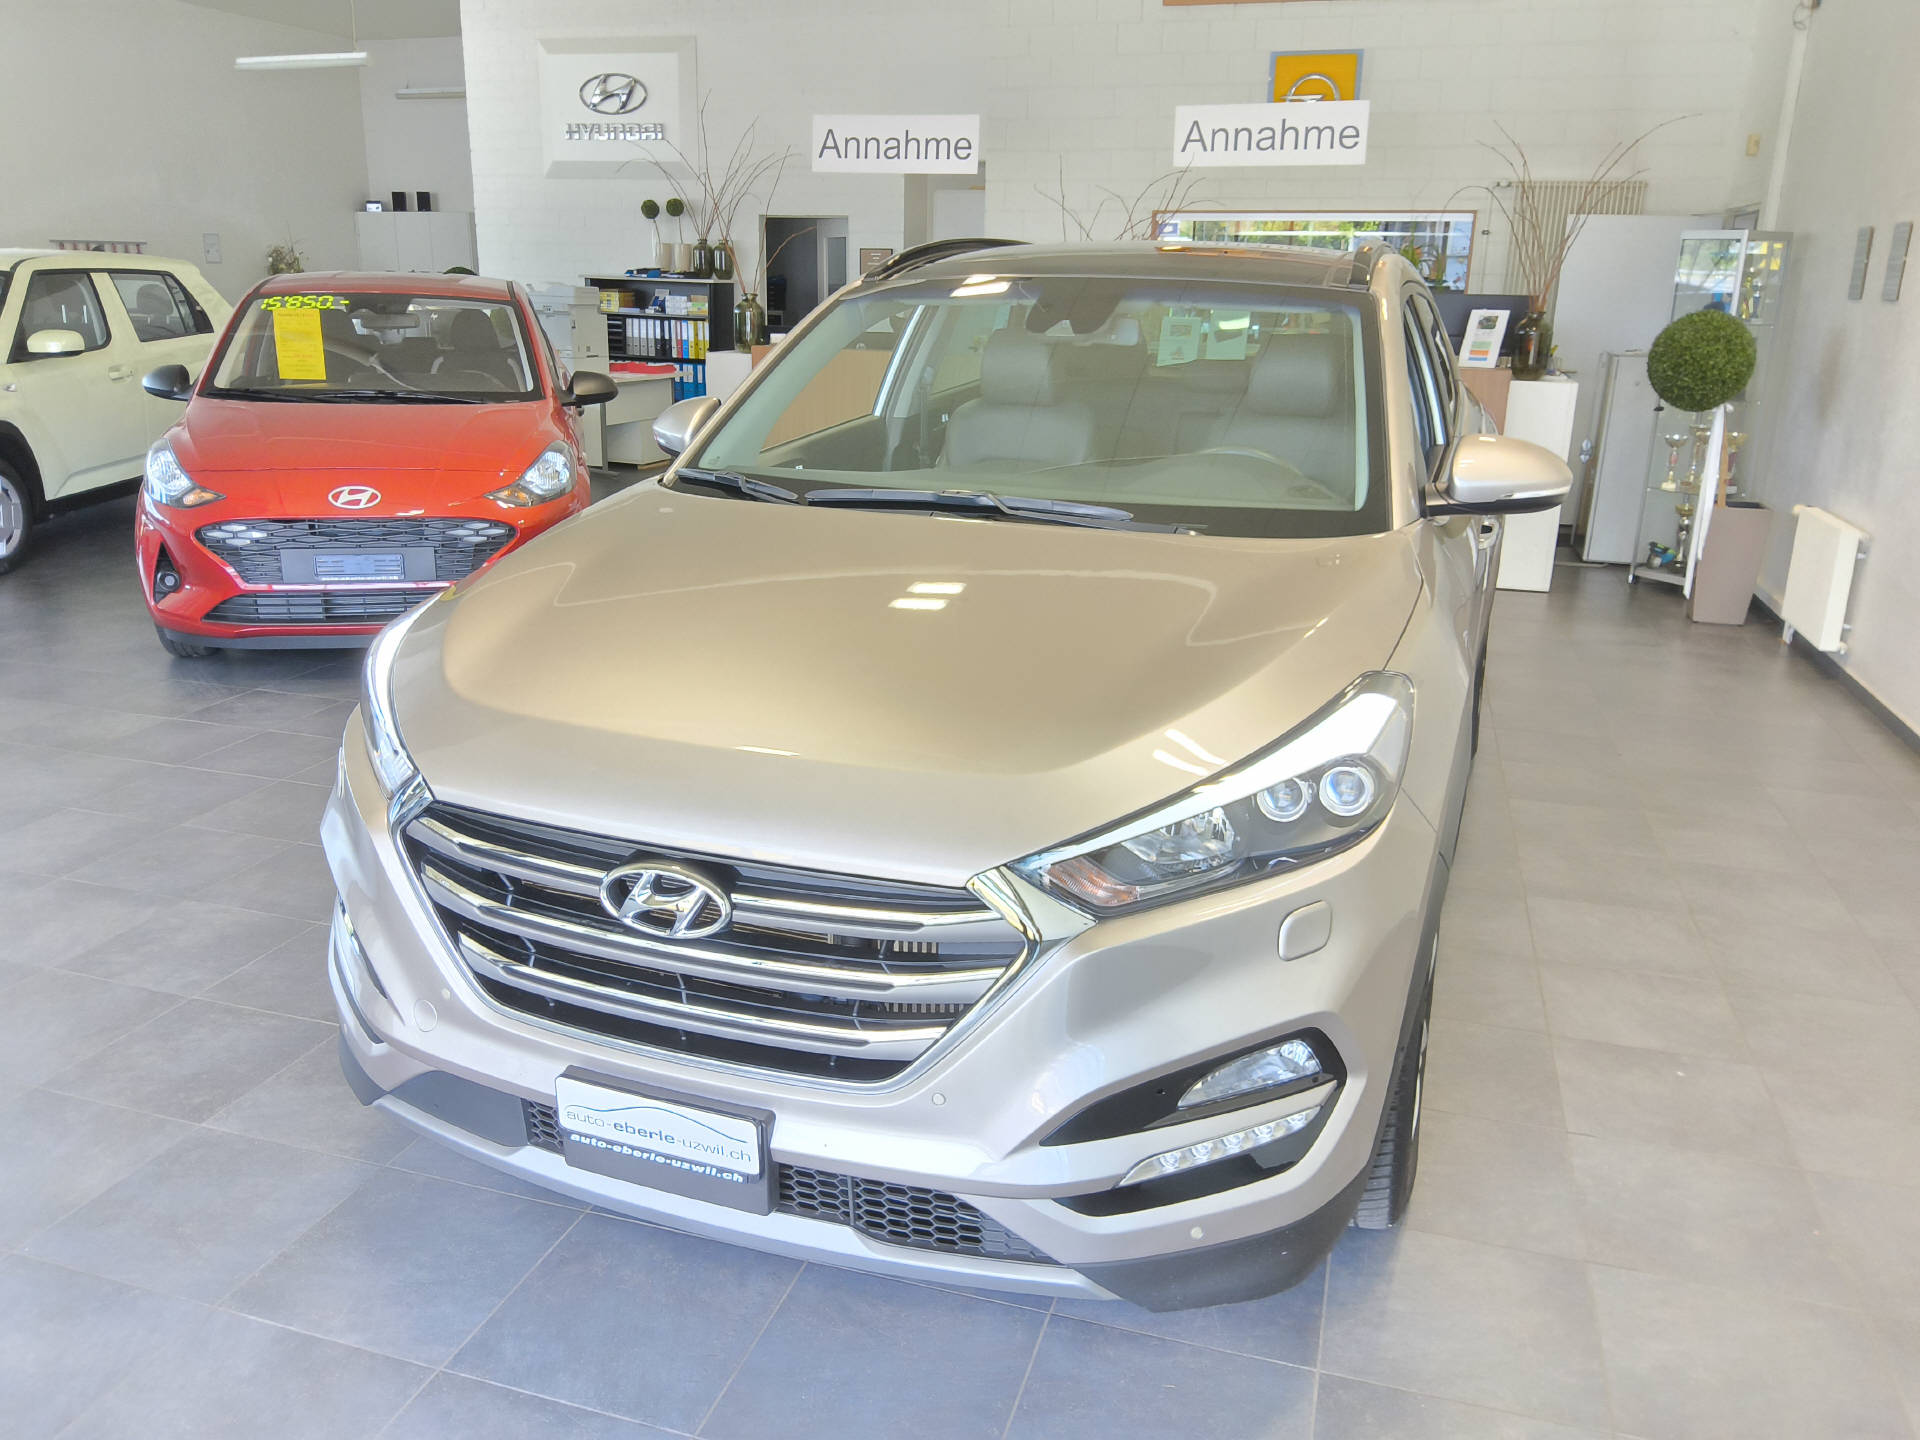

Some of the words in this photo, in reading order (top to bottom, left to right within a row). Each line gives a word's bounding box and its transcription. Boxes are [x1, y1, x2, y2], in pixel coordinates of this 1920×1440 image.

[565, 123, 664, 141] HYUNDAI
[818, 128, 972, 160] Annahme
[1181, 118, 1360, 152] Annahme
[566, 1109, 752, 1163] auto-eberle-uzwil.ch
[570, 1133, 744, 1183] auto-eberle-uzwil.ch
